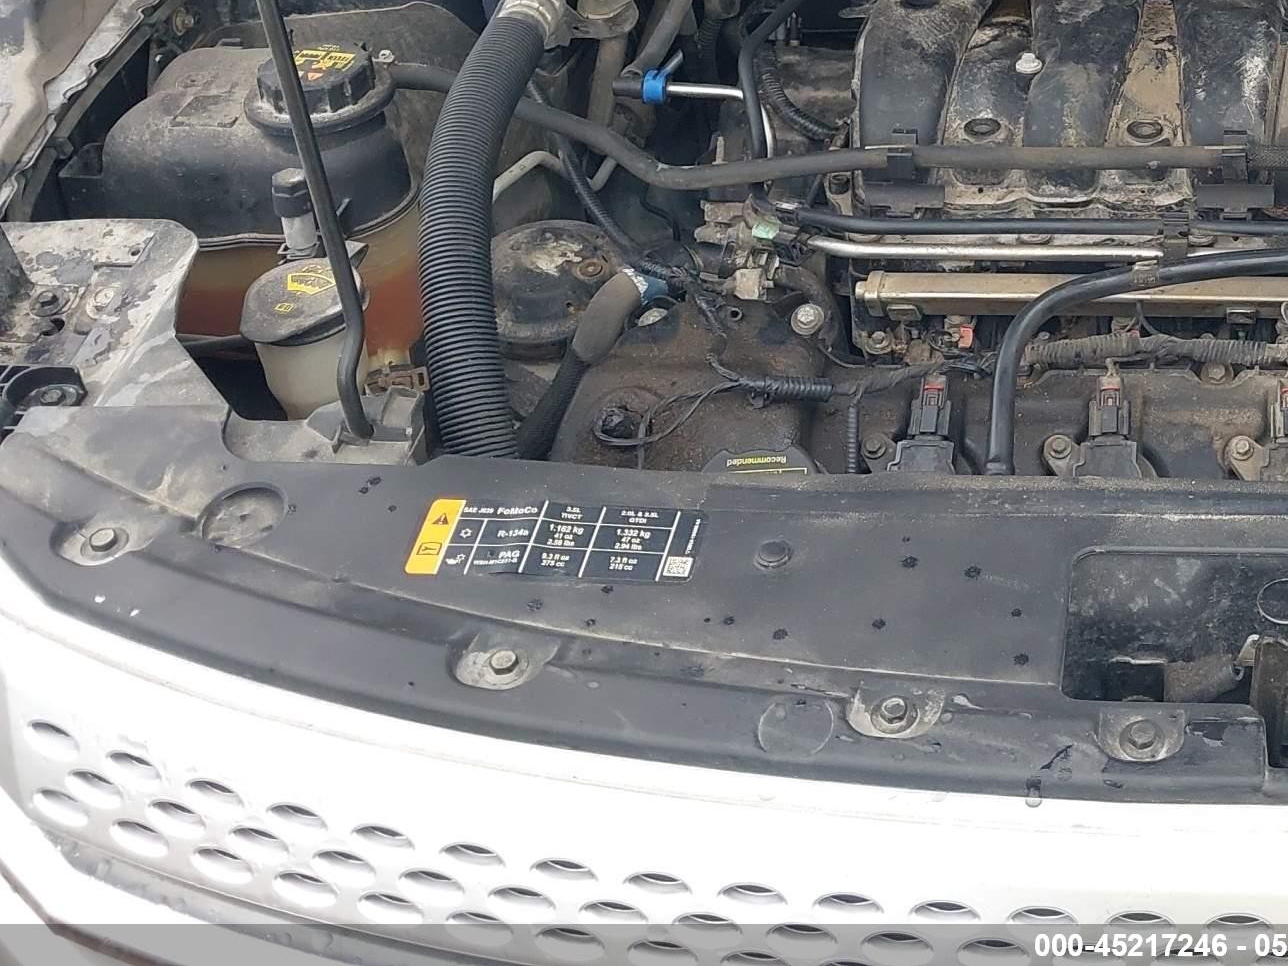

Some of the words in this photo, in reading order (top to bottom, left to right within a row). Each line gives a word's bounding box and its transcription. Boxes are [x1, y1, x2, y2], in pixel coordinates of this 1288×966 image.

[726, 455, 787, 467] Recommended
[497, 506, 538, 515] FoMoCo
[497, 528, 530, 538] R-134a
[572, 526, 585, 536] kg
[616, 528, 639, 536] 1.332
[639, 530, 652, 539] kg
[614, 542, 630, 550] 2.94
[630, 543, 643, 551] lbs
[498, 549, 521, 559] PAG
[541, 559, 556, 567] 275
[609, 556, 621, 564] 7.3
[608, 563, 623, 571] 215
